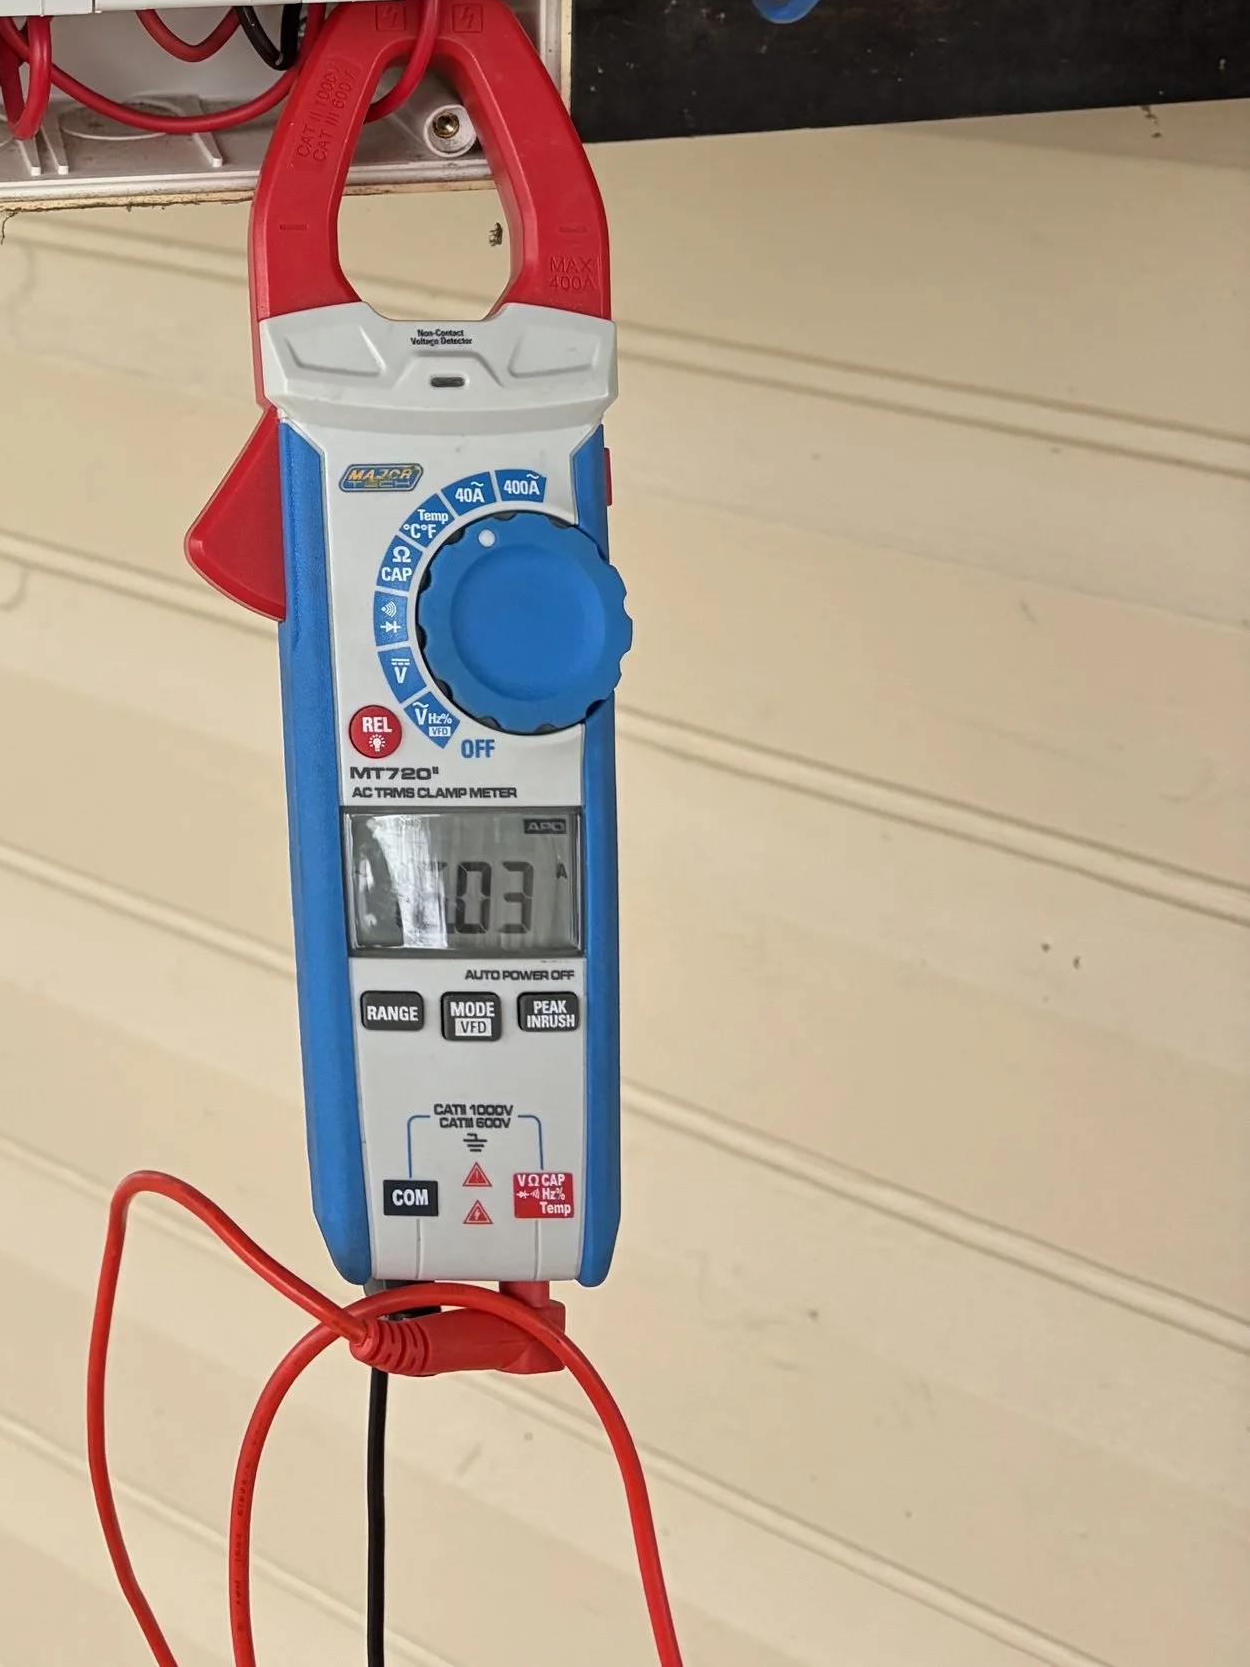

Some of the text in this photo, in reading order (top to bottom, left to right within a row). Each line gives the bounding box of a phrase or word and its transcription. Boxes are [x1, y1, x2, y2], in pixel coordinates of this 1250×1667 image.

[296, 122, 316, 159] CAT
[311, 128, 334, 163] CAT
[549, 255, 593, 274] MAX
[549, 274, 597, 292] 400A
[417, 328, 465, 338] Non-Contact
[410, 336, 473, 347] Voltage Detector
[417, 508, 450, 525] Temp
[381, 566, 414, 582] CAP
[361, 716, 393, 733] REL
[431, 727, 449, 736] VFD
[461, 738, 495, 759] OFF
[351, 786, 518, 799] AC TRMS CLAMP METER
[526, 821, 566, 832] APO
[464, 969, 576, 981] AUTO POWER OFF
[366, 1005, 419, 1022] RANGE
[449, 1001, 496, 1017] MODE
[533, 999, 567, 1015] PEAK
[460, 1020, 488, 1034] VFD
[526, 1014, 576, 1029] INRUSH
[469, 1103, 514, 1117] 1000V
[475, 1117, 512, 1129] 600V
[541, 1173, 566, 1187] CAP
[391, 1188, 429, 1207] COM
[539, 1201, 572, 1217] Temp
